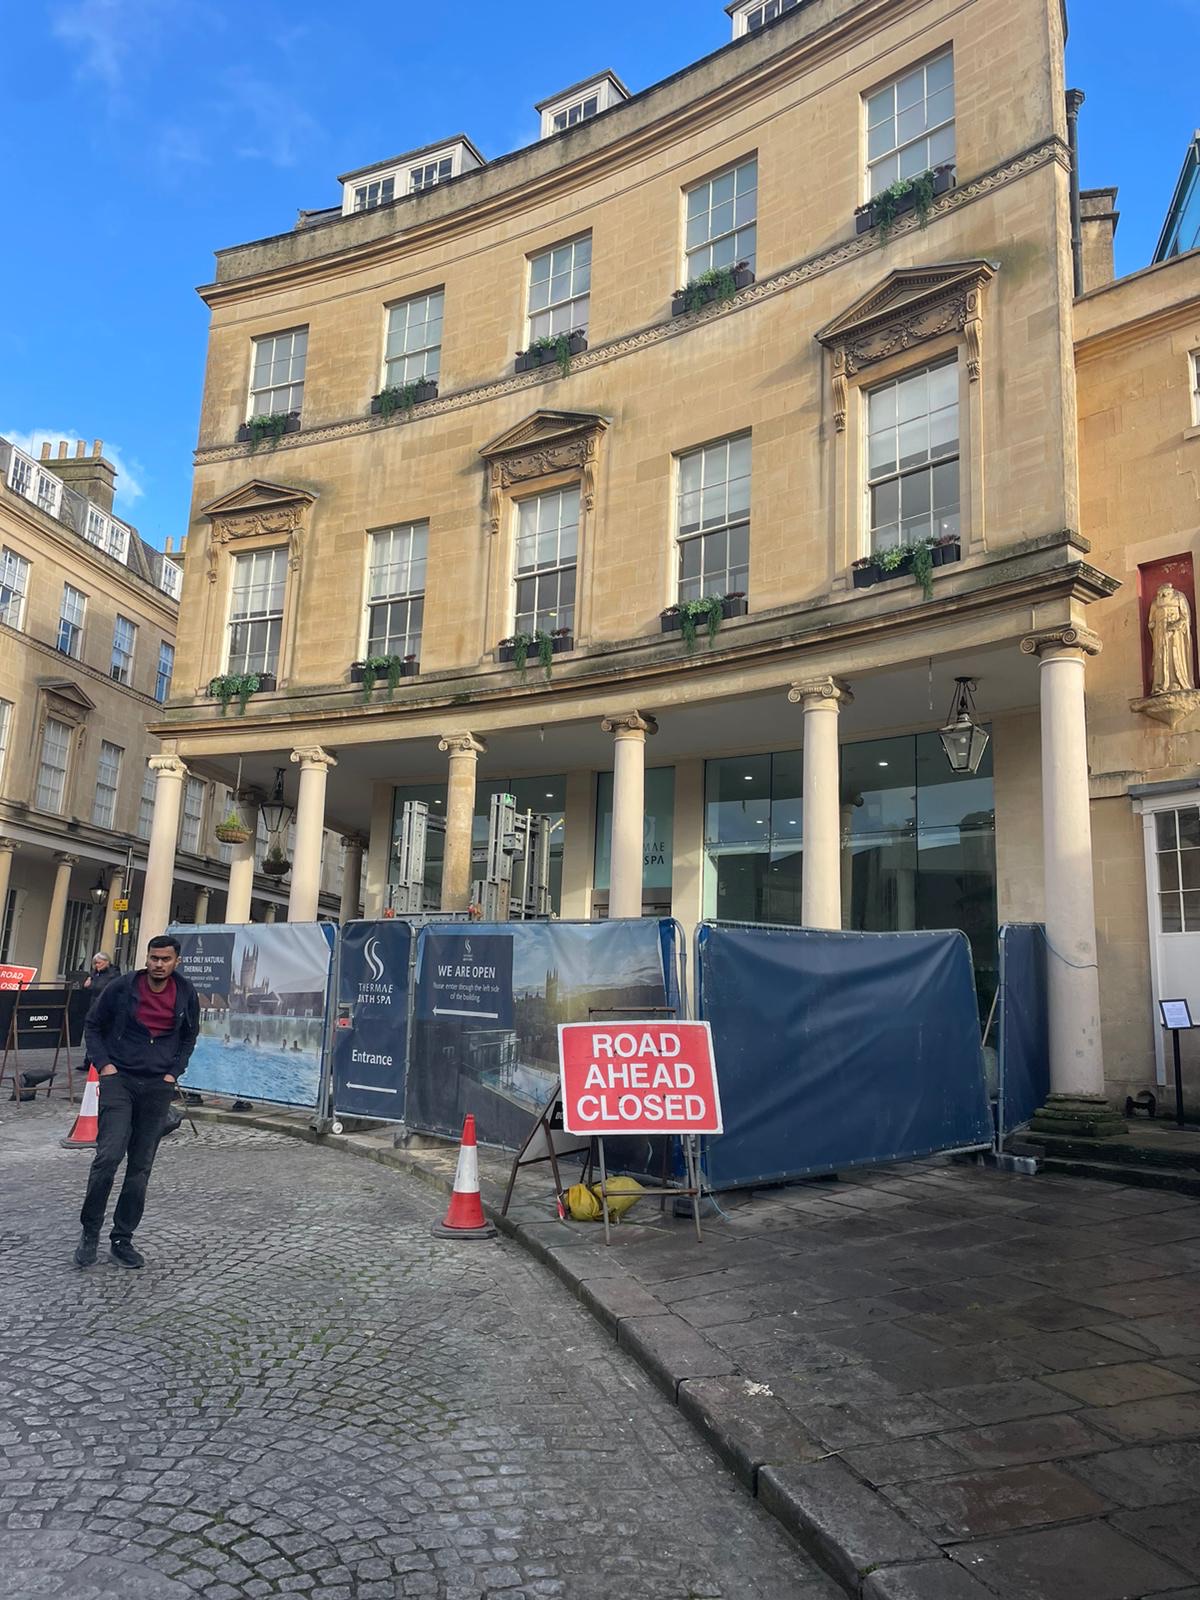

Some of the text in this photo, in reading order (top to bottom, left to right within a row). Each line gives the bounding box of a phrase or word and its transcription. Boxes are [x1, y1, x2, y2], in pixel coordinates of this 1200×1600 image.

[644, 855, 664, 865] SPA
[0, 970, 24, 979] ROAD
[438, 965, 496, 979] WE ARE OPEN
[358, 983, 394, 993] THERMAE
[376, 995, 392, 1005] SPA
[592, 1032, 681, 1058] ROAD
[351, 1049, 393, 1066] Entrance
[584, 1063, 695, 1089] AHEAD
[576, 1094, 706, 1121] CLOSED
